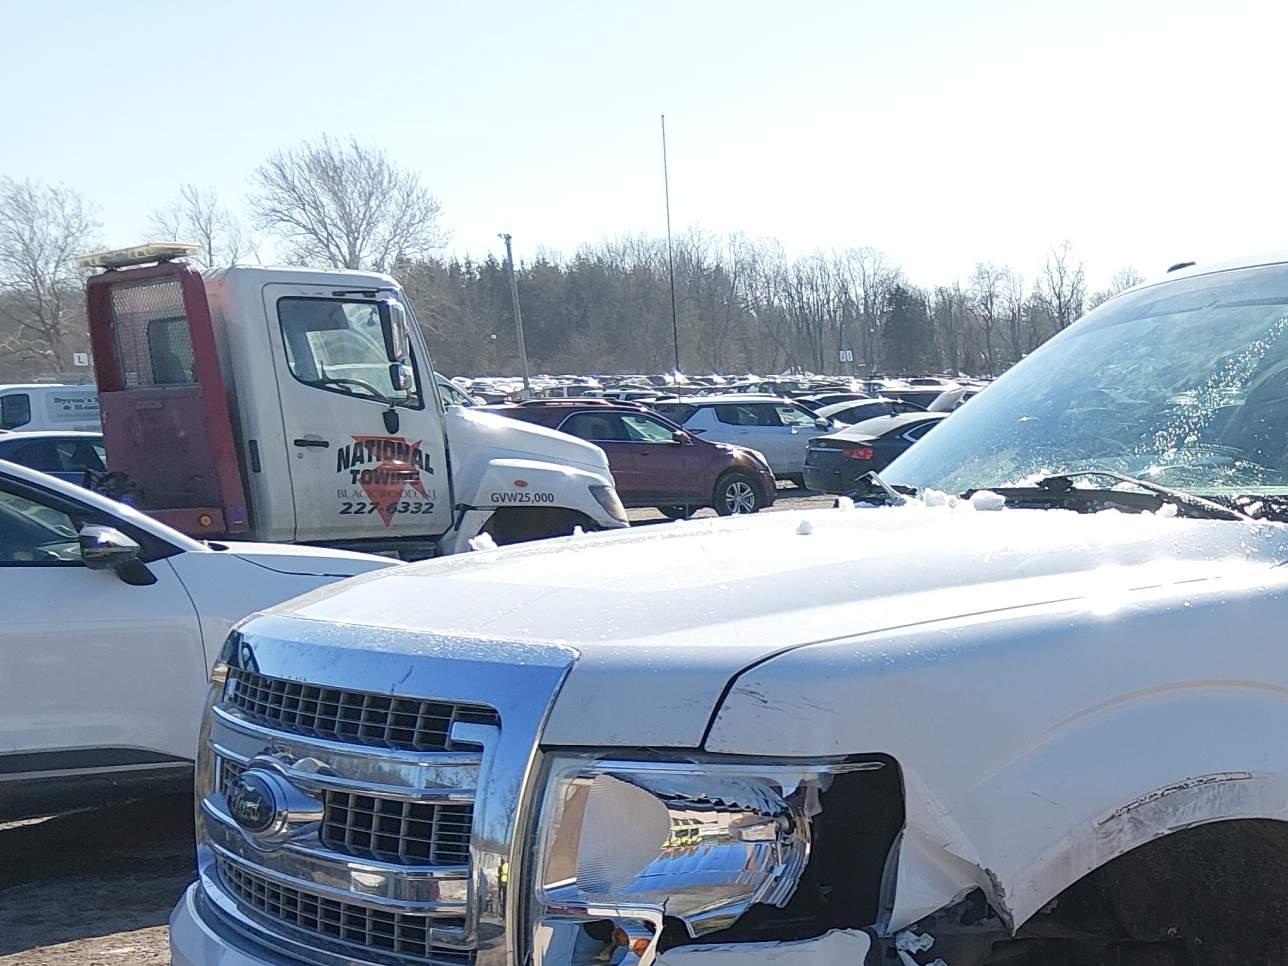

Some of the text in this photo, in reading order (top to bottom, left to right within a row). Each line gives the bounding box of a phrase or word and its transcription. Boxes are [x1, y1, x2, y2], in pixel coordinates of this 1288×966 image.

[336, 440, 434, 475] NATIONAL
[350, 469, 420, 485] TOWING
[490, 491, 555, 504] GVW25,000
[339, 501, 435, 515] 227-6332
